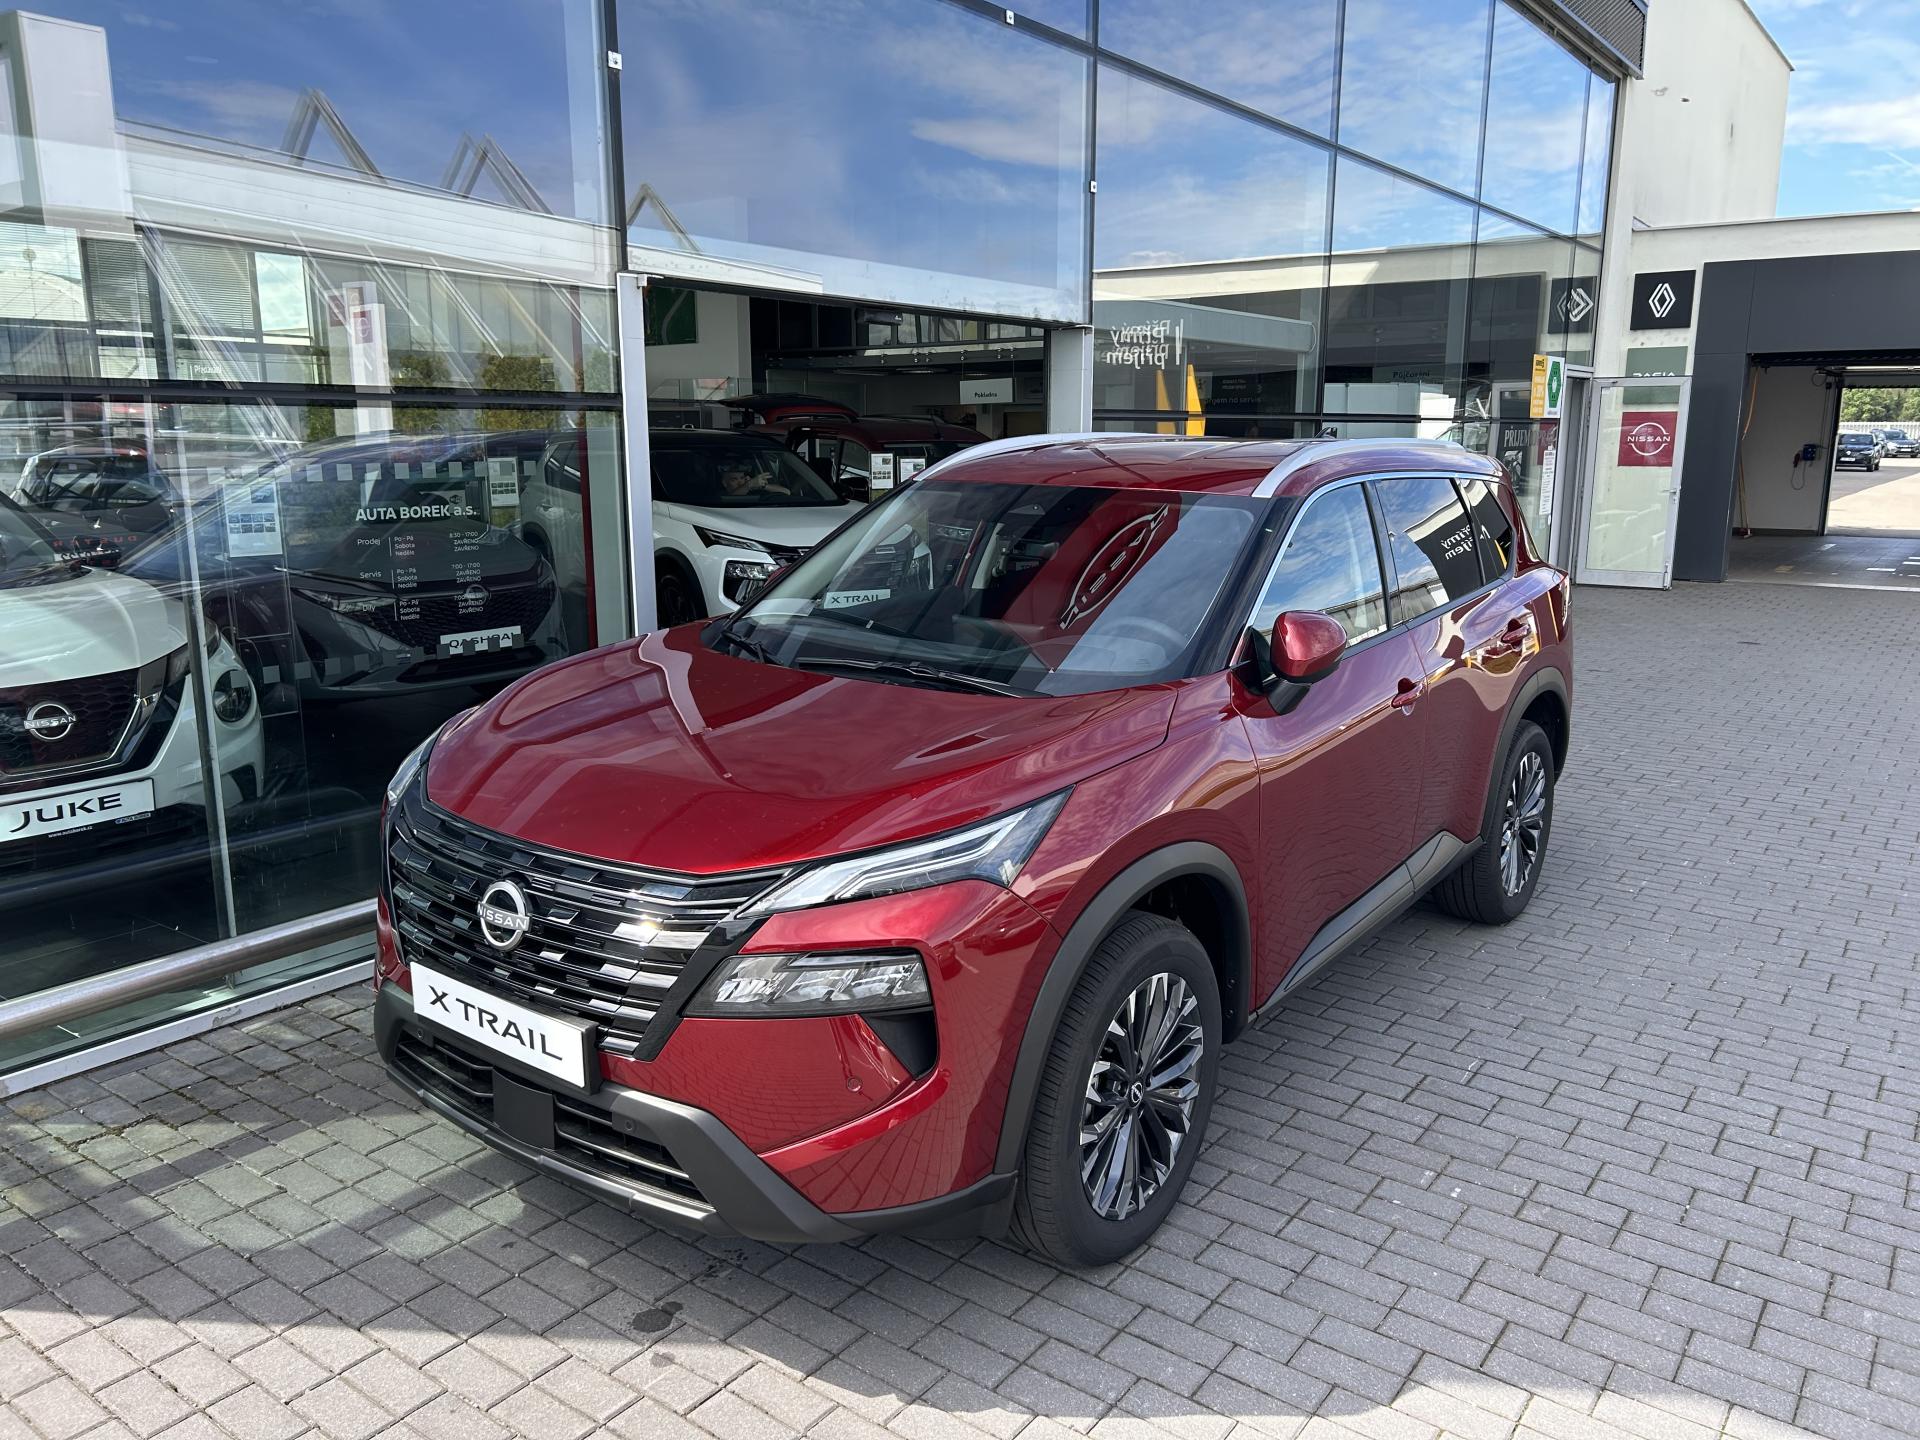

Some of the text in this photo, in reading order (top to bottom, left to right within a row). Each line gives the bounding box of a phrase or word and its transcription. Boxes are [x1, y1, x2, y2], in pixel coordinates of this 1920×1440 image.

[355, 505, 477, 521] AUTA BOREK a.s.
[357, 538, 381, 546] Prodej
[360, 571, 382, 579] Servis
[396, 574, 418, 582] Sobota
[456, 575, 482, 584] ZAVŘENO
[831, 596, 840, 604] X
[399, 606, 420, 614] Sobota
[25, 715, 77, 728] NISSAN
[9, 793, 122, 833] JUKE
[477, 903, 528, 930] NISSAN
[428, 984, 563, 1062] X TRAIL
